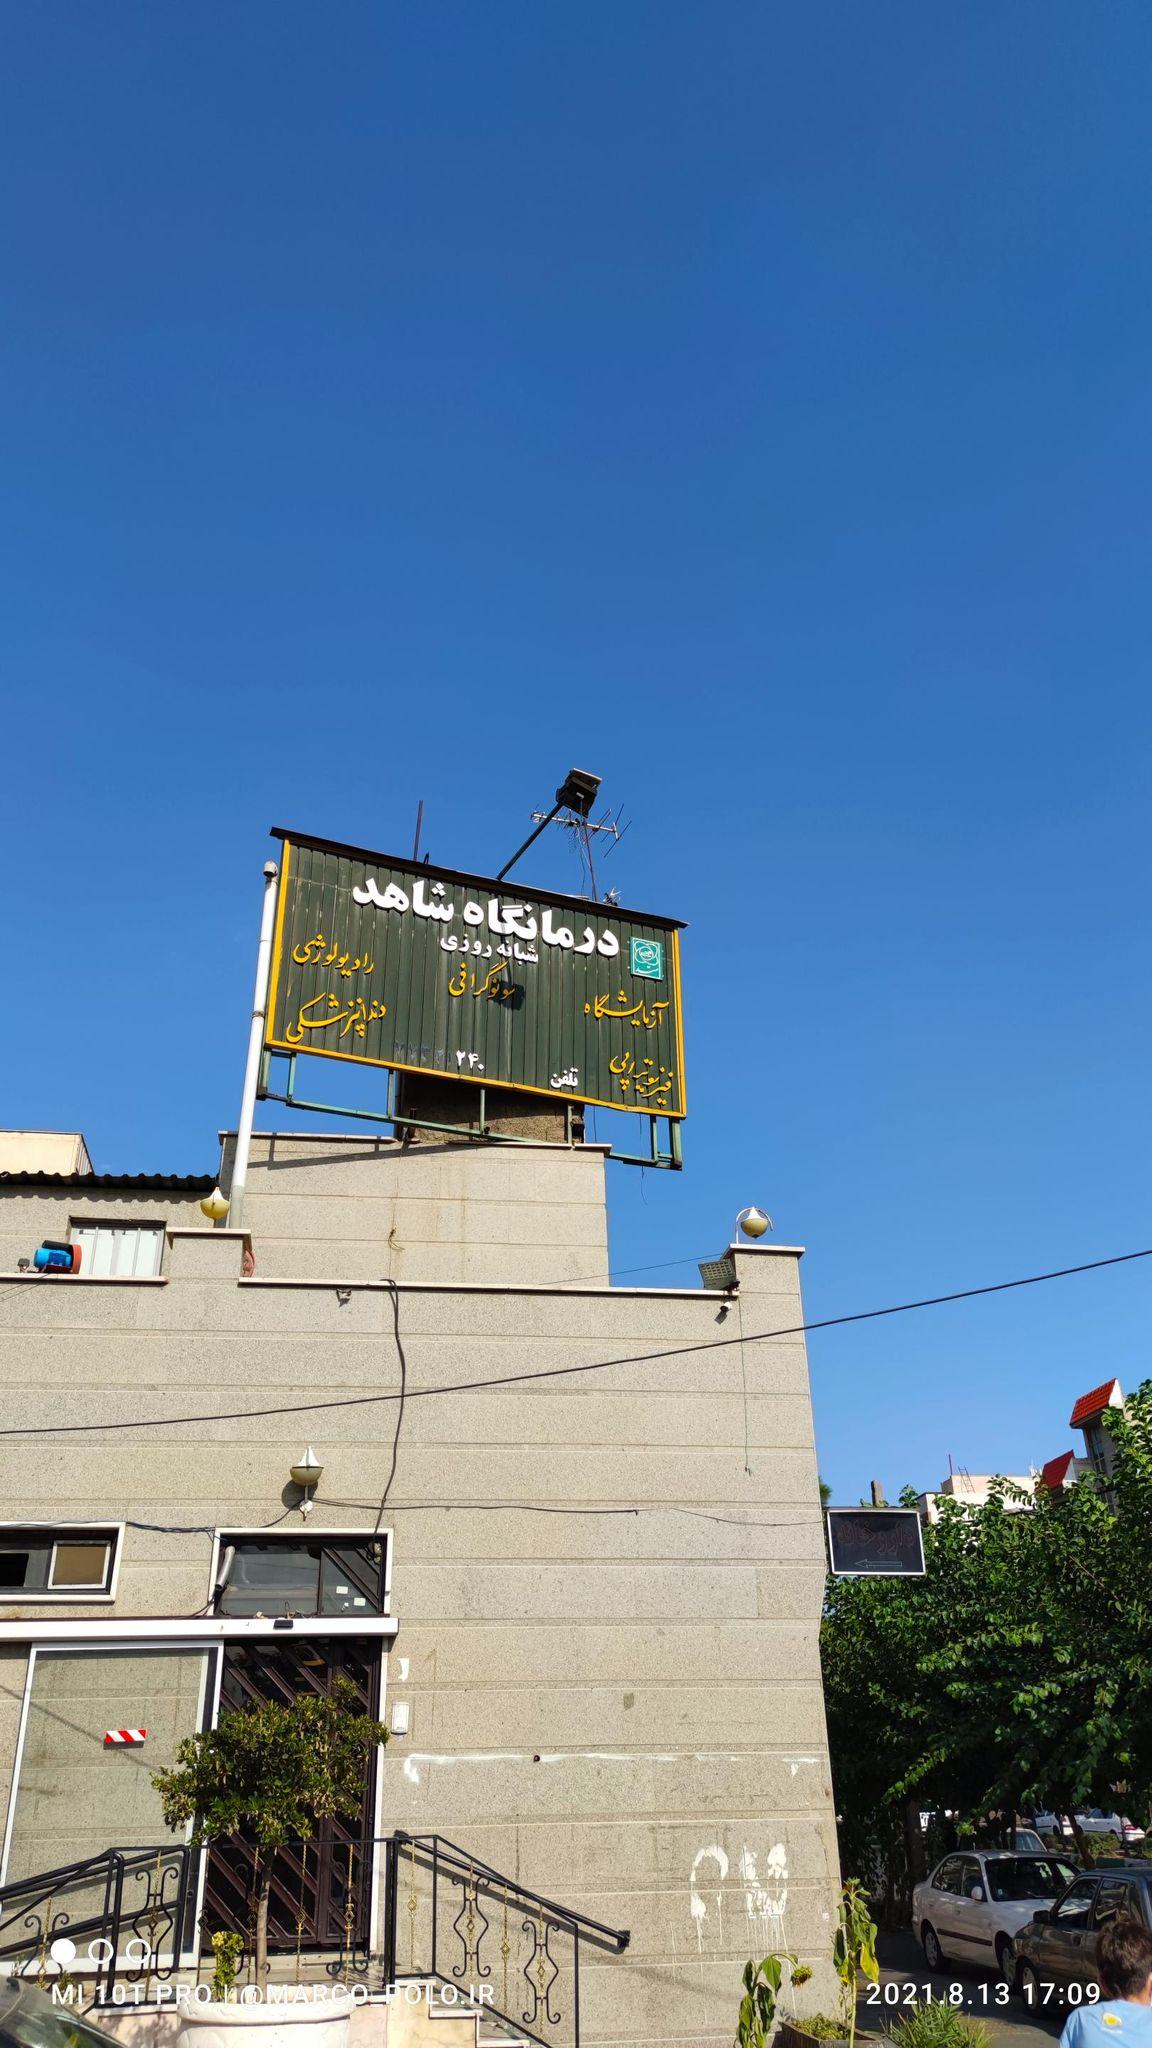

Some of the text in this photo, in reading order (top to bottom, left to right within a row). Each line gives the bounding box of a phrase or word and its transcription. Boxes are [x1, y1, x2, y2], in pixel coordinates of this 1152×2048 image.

[352, 877, 620, 957] درمانگاه شاهد
[292, 934, 375, 978] رادیولوژی
[440, 933, 539, 965] شبانه روزی
[448, 960, 516, 1001] سونوگرافی
[285, 992, 387, 1044] دندانپزشکی
[584, 990, 670, 1029] آزمایشگاه
[550, 1067, 579, 1089] تلفن
[609, 1051, 673, 1105] فیزیوتراپی
